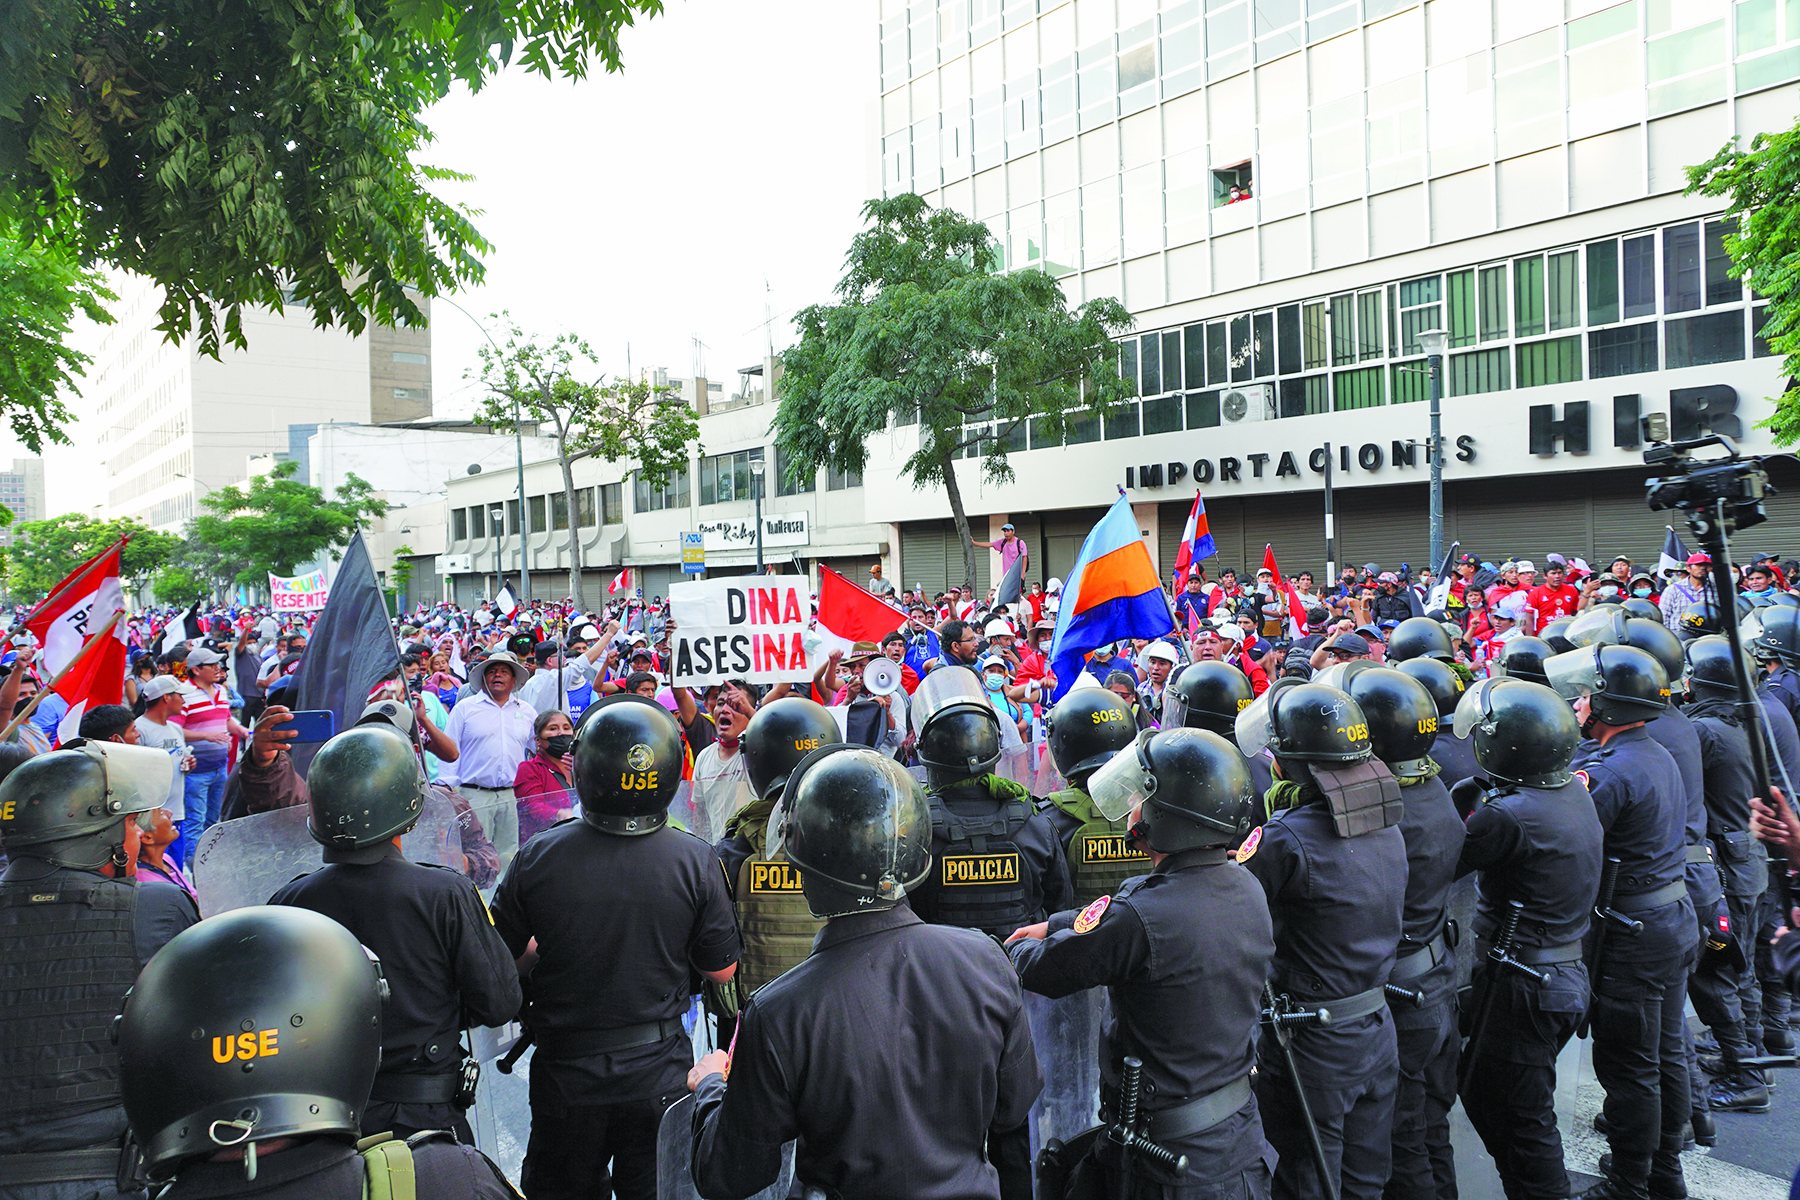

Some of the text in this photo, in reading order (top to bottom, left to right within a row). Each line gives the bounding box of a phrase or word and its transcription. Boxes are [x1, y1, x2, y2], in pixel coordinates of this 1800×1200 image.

[1125, 435, 1477, 490] IMPORTACIONES
[726, 587, 802, 625] DINA
[676, 632, 807, 677] ASESINA
[1091, 708, 1123, 724] SOES
[1417, 717, 1437, 734] USE
[794, 738, 819, 751] USE
[620, 770, 659, 791] USE
[1087, 839, 1148, 859] POLIC
[754, 866, 803, 889] POLI
[946, 858, 1015, 881] POLICIA
[212, 1028, 279, 1064] USE
